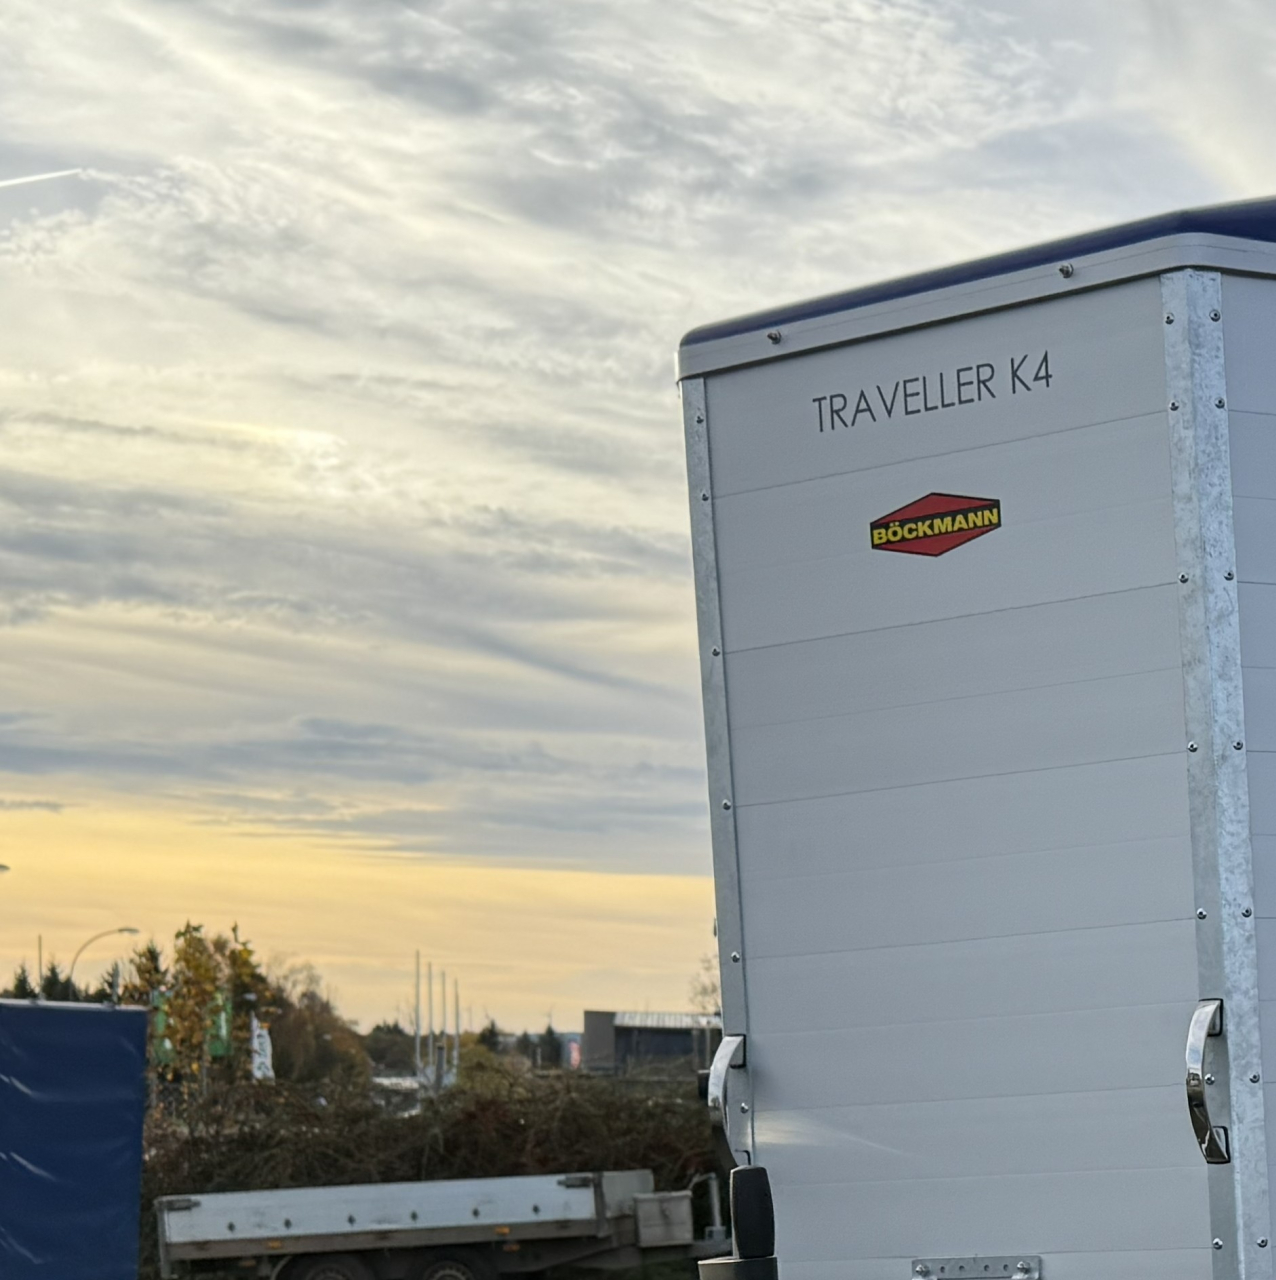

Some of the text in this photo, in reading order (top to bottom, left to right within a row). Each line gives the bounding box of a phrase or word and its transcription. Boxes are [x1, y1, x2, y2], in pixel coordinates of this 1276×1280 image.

[812, 350, 1053, 432] TRAVELLER K4
[872, 508, 999, 545] BÖCKMANN
